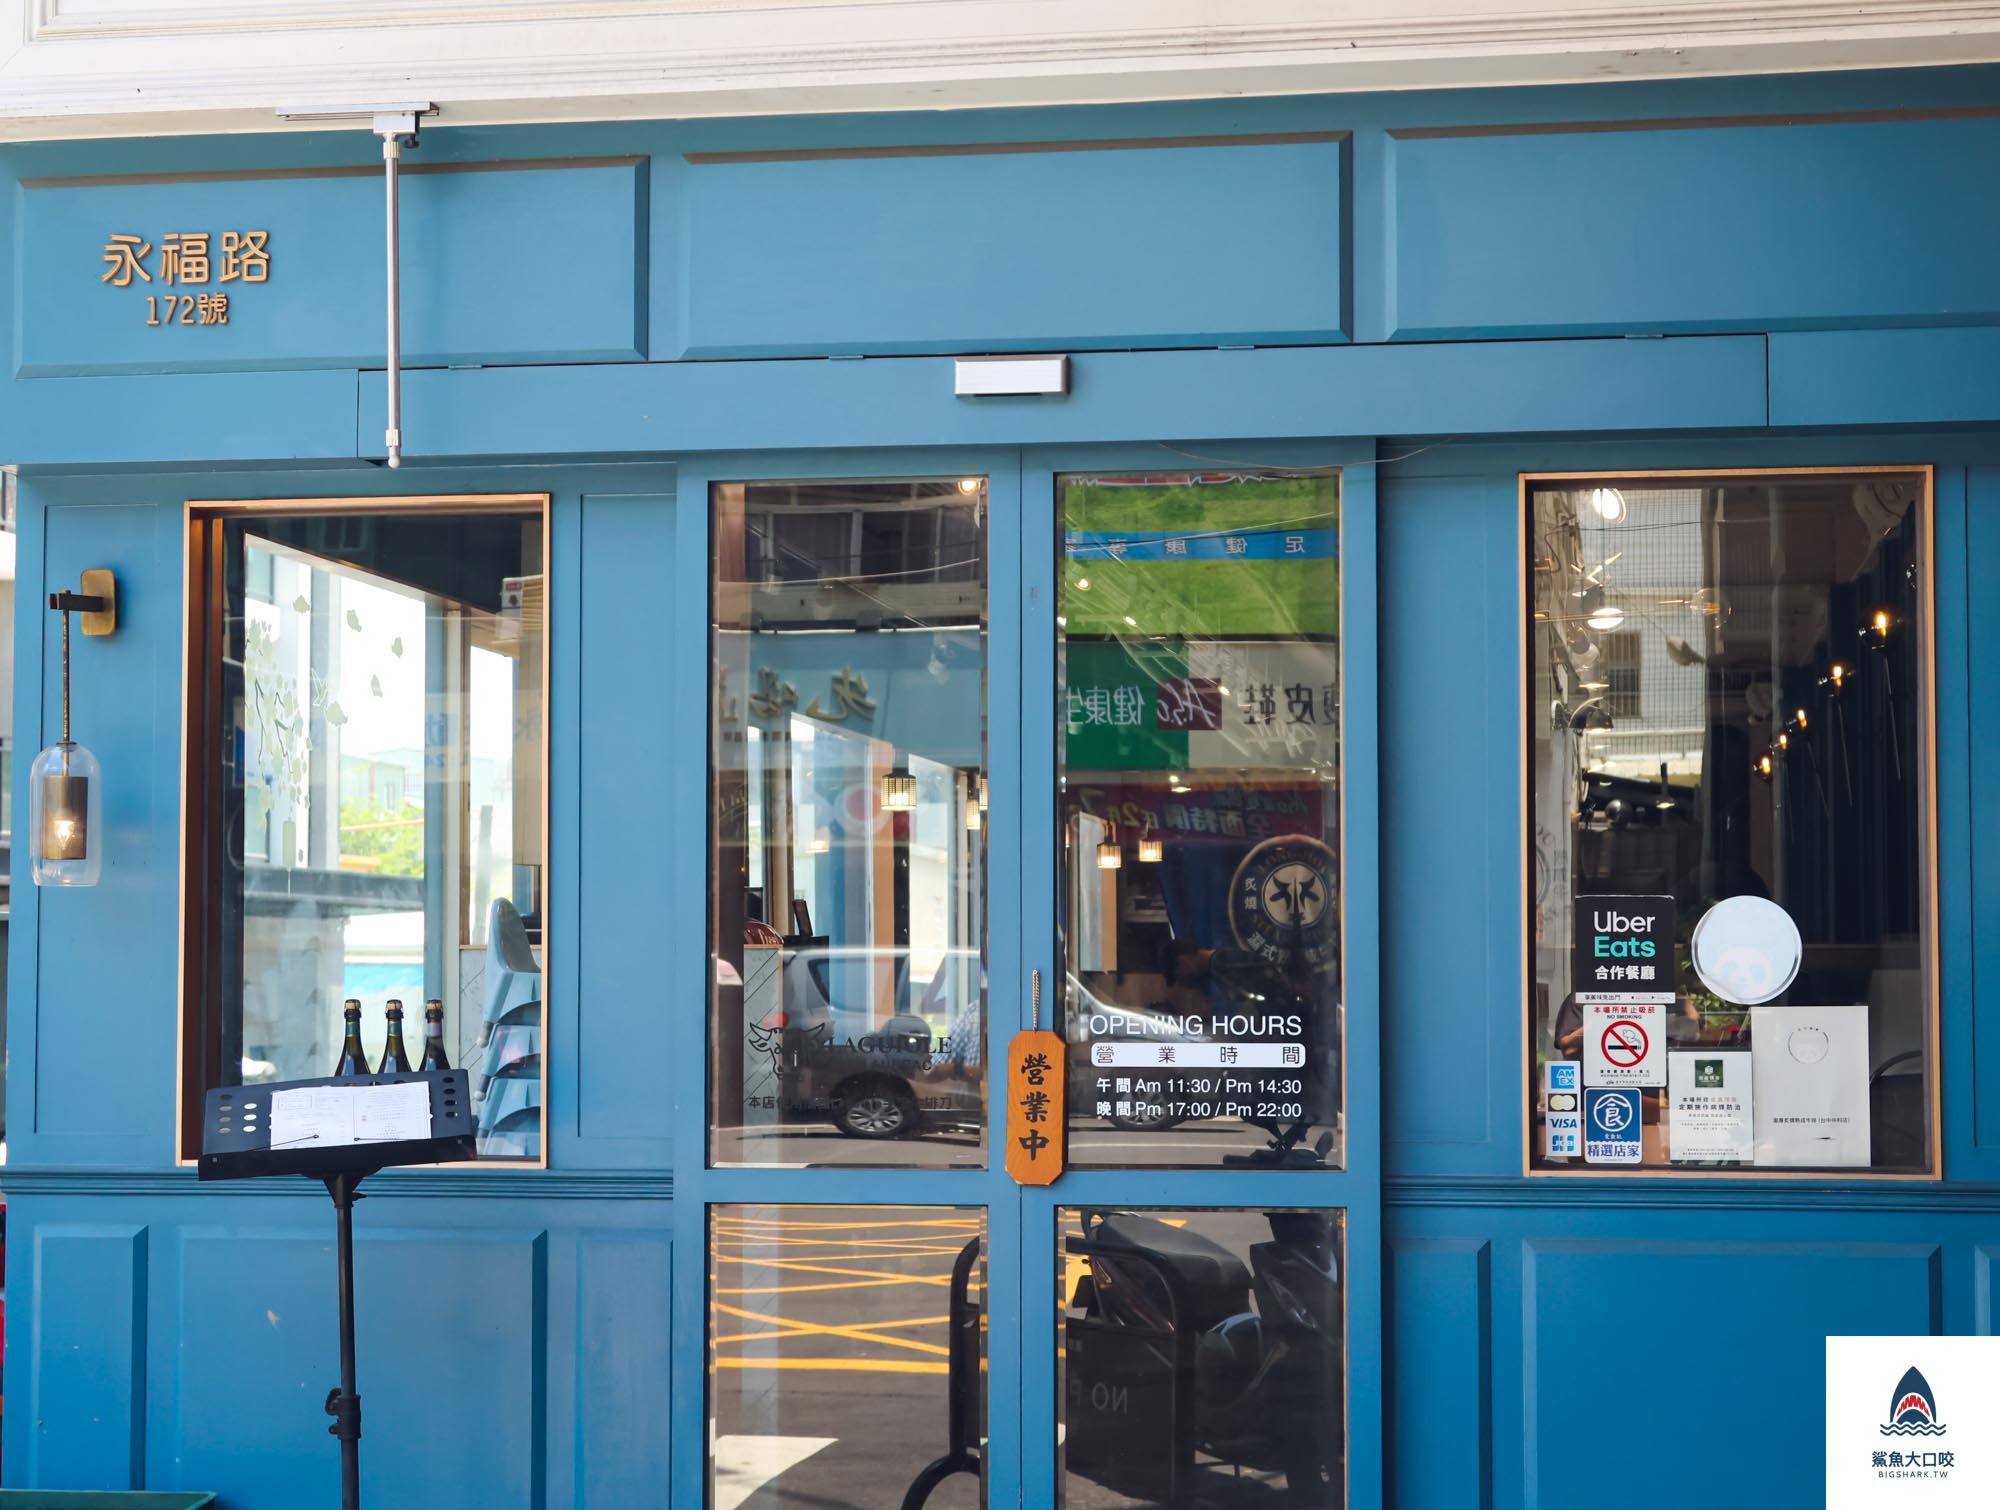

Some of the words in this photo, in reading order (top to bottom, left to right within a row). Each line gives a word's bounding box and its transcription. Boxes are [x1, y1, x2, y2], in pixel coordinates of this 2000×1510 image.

[102, 231, 271, 286] 永福路
[146, 292, 229, 325] 172號
[1594, 911, 1656, 933] Uber
[1594, 936, 1656, 958] Eats
[1594, 965, 1656, 980] 合作餐廳
[1089, 1014, 1203, 1036] OPENING
[1212, 1014, 1302, 1036] HOURS
[1096, 1045, 1301, 1065] 營業時間
[1557, 1069, 1575, 1078] AM
[1559, 1077, 1575, 1086] EX
[1096, 1078, 1132, 1094] 午間
[1135, 1079, 1161, 1094] Am
[1167, 1079, 1211, 1094] 11:30
[1226, 1079, 1252, 1094] Pm
[1257, 1079, 1302, 1094] 14:30
[1018, 1053, 1052, 1161] 營業中
[1096, 1102, 1132, 1117] 晚間
[1135, 1103, 1161, 1117] Pm
[1167, 1103, 1211, 1117] 17:00
[1226, 1103, 1252, 1117] Pm
[1257, 1103, 1302, 1118] 22:00
[1550, 1118, 1577, 1128] VISA
[1587, 1144, 1640, 1157] 精選店家
